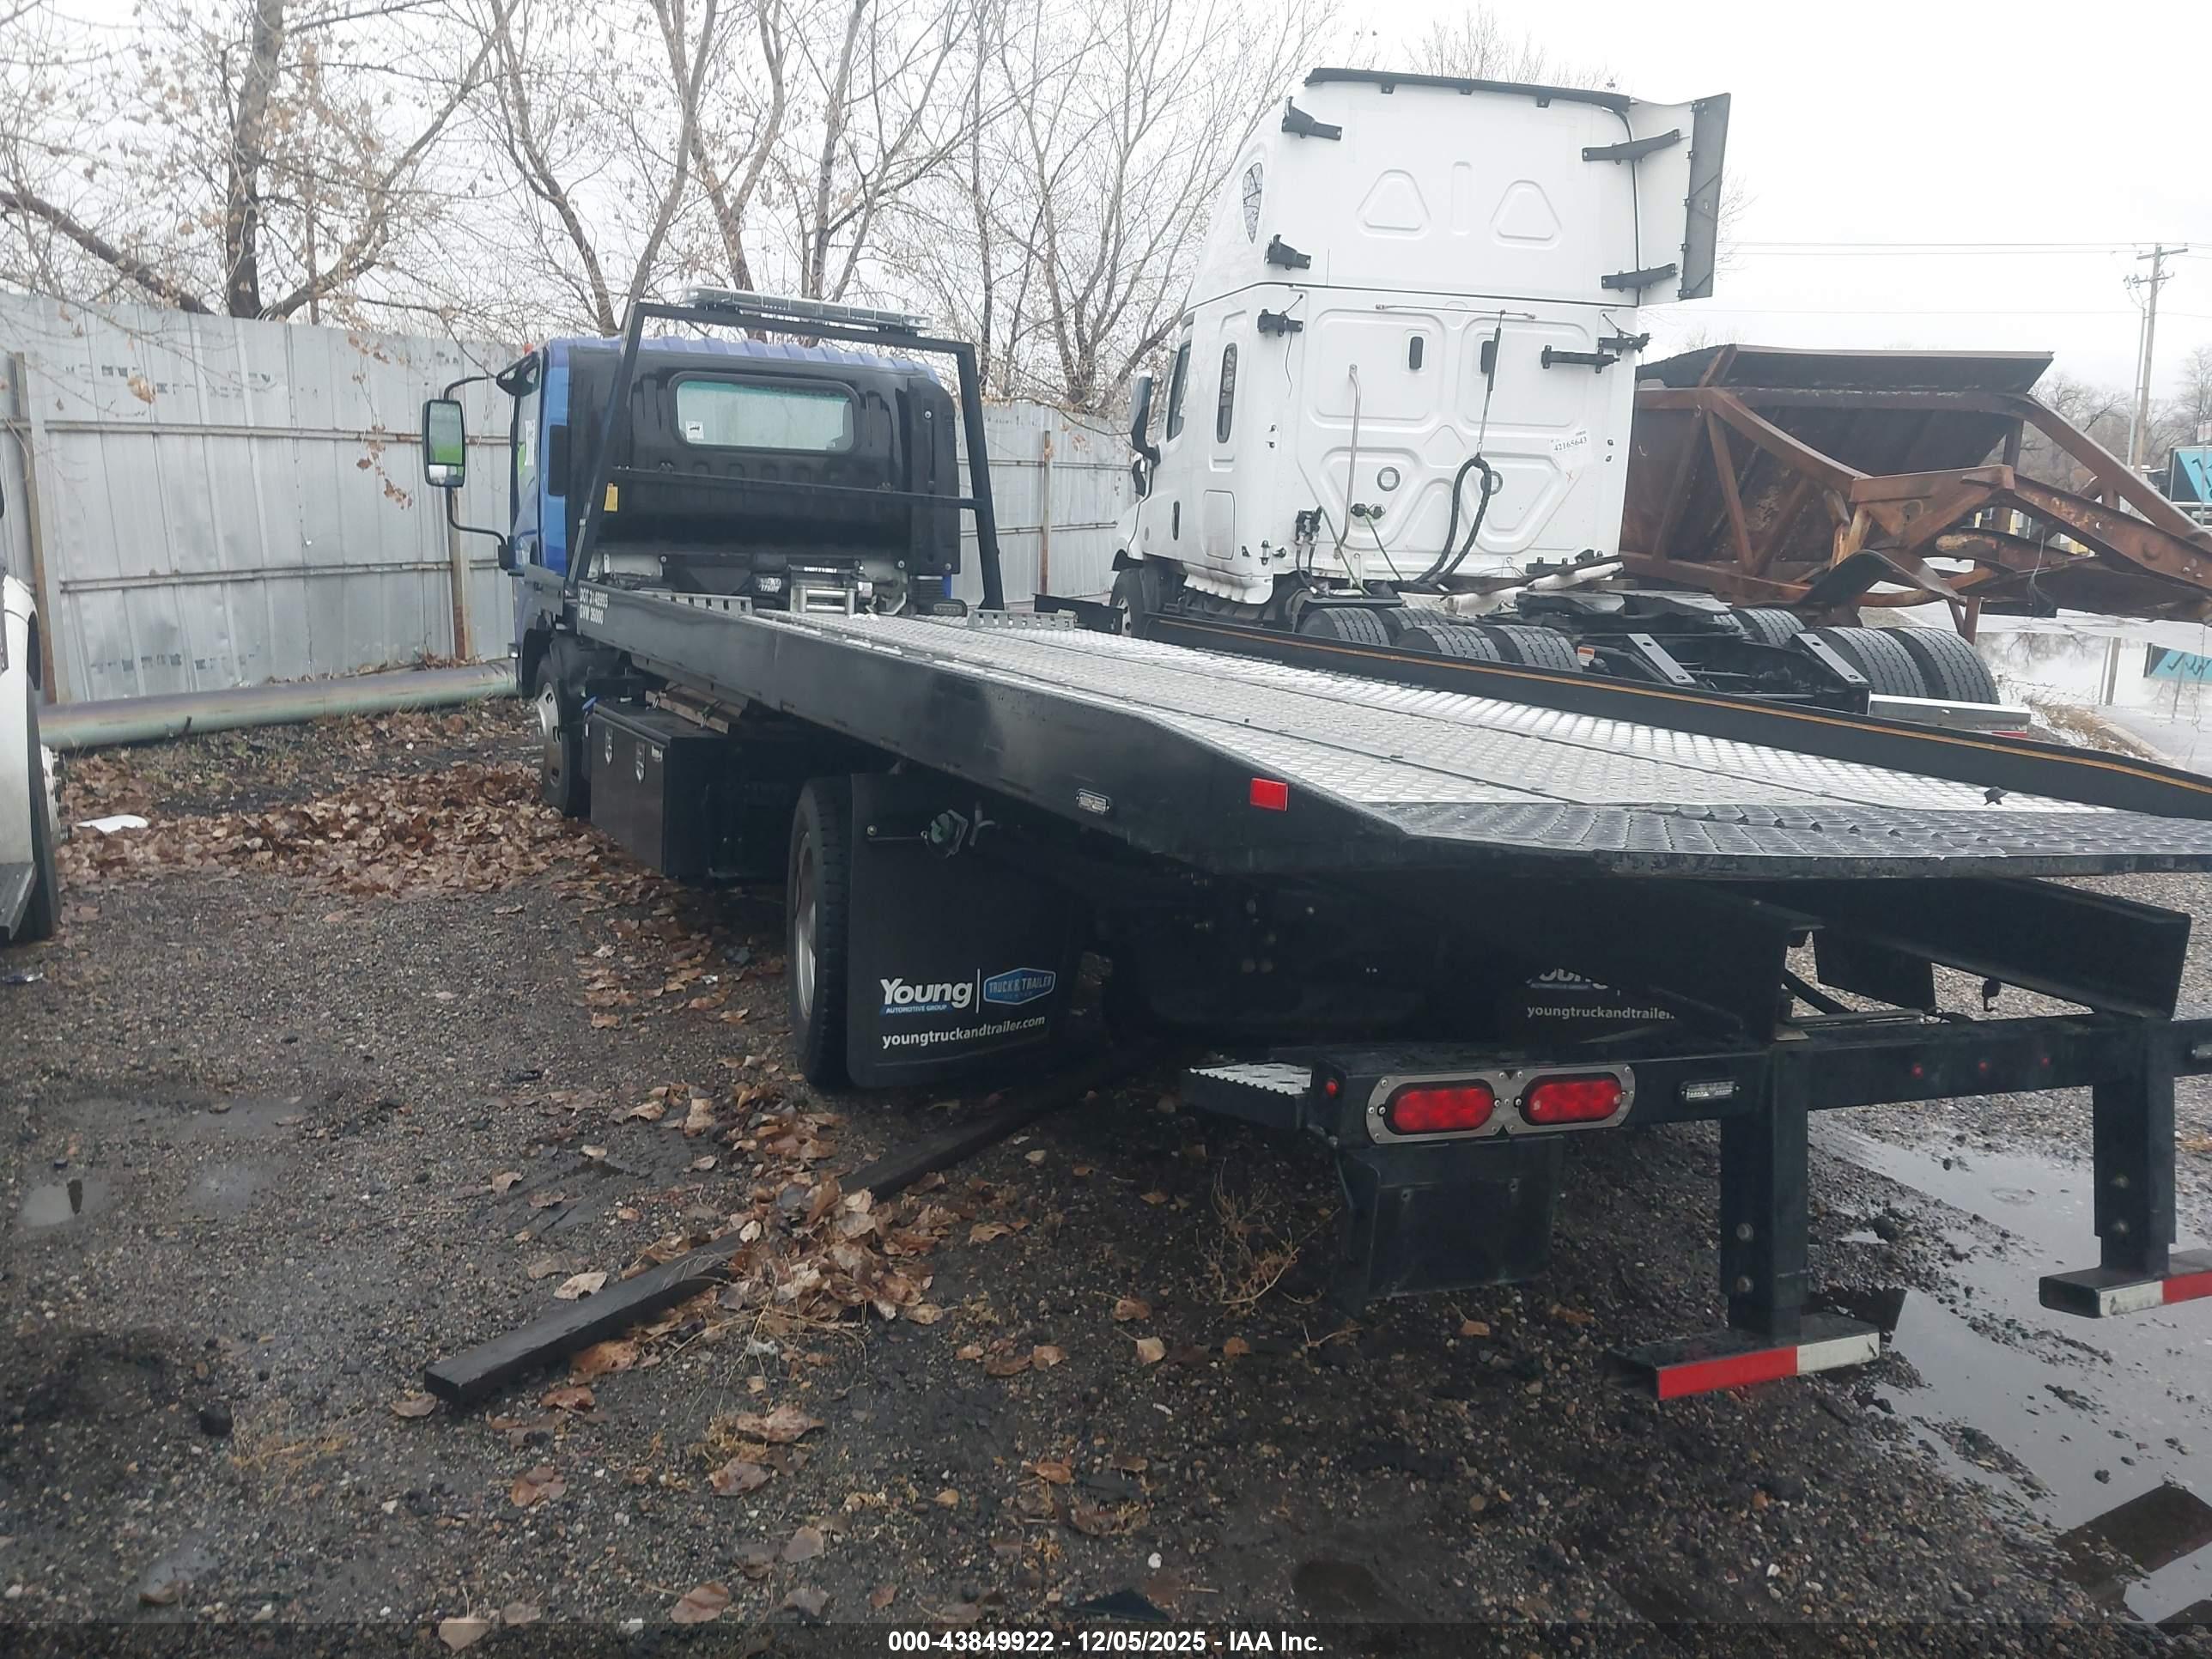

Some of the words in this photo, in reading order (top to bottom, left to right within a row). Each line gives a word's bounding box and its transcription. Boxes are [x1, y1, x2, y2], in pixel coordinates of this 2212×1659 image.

[1554, 436, 1587, 451] 42165643
[580, 586, 589, 605] DOT
[580, 605, 589, 620] GVW
[880, 978, 973, 1009] Young
[988, 981, 1013, 994] TRUCK
[1022, 975, 1052, 990] TRAILER
[885, 1006, 926, 1014] AUTOMOTIVE
[882, 1015, 1045, 1049] youngtruckandtrailer.com
